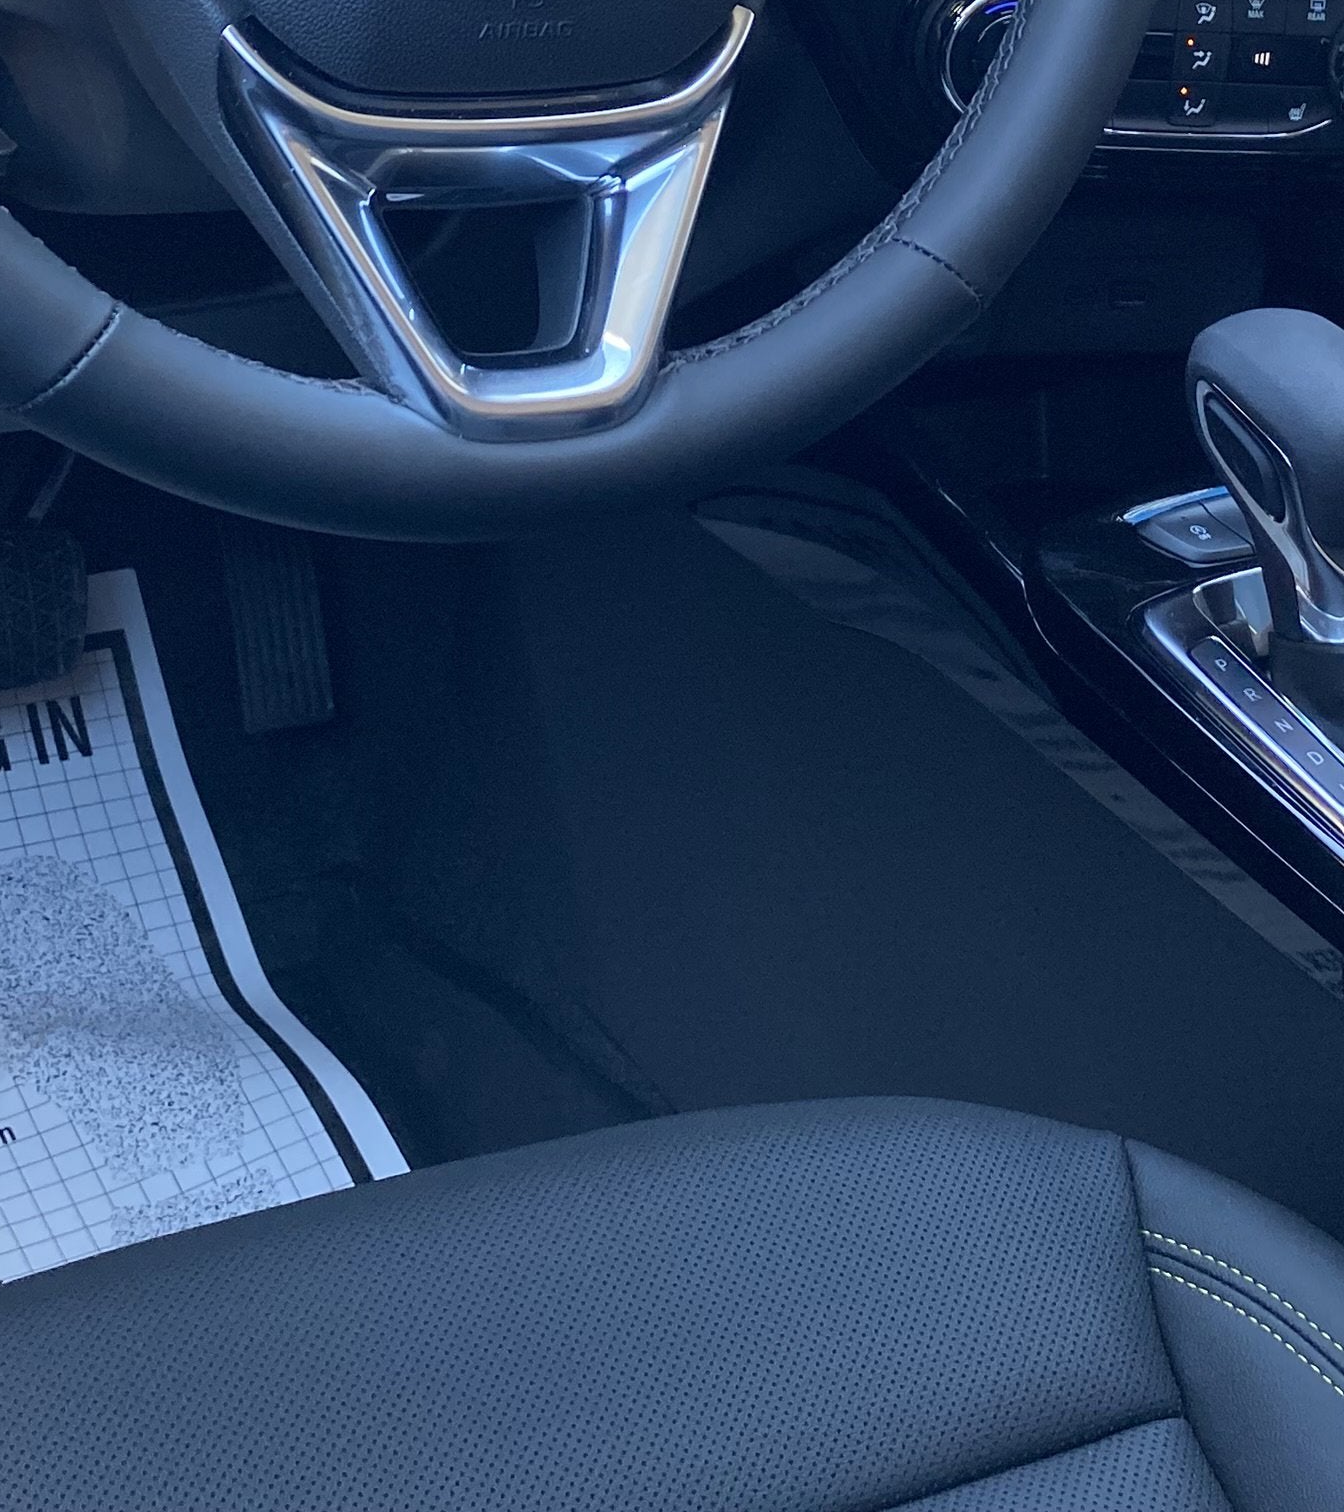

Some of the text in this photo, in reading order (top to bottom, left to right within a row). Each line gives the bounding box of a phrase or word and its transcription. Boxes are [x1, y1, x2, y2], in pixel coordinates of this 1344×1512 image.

[478, 20, 575, 39] AIRBAG
[1214, 658, 1229, 672] P
[1242, 687, 1263, 702] R
[29, 696, 94, 764] IN
[1274, 718, 1294, 733] N
[1306, 751, 1325, 766] D
